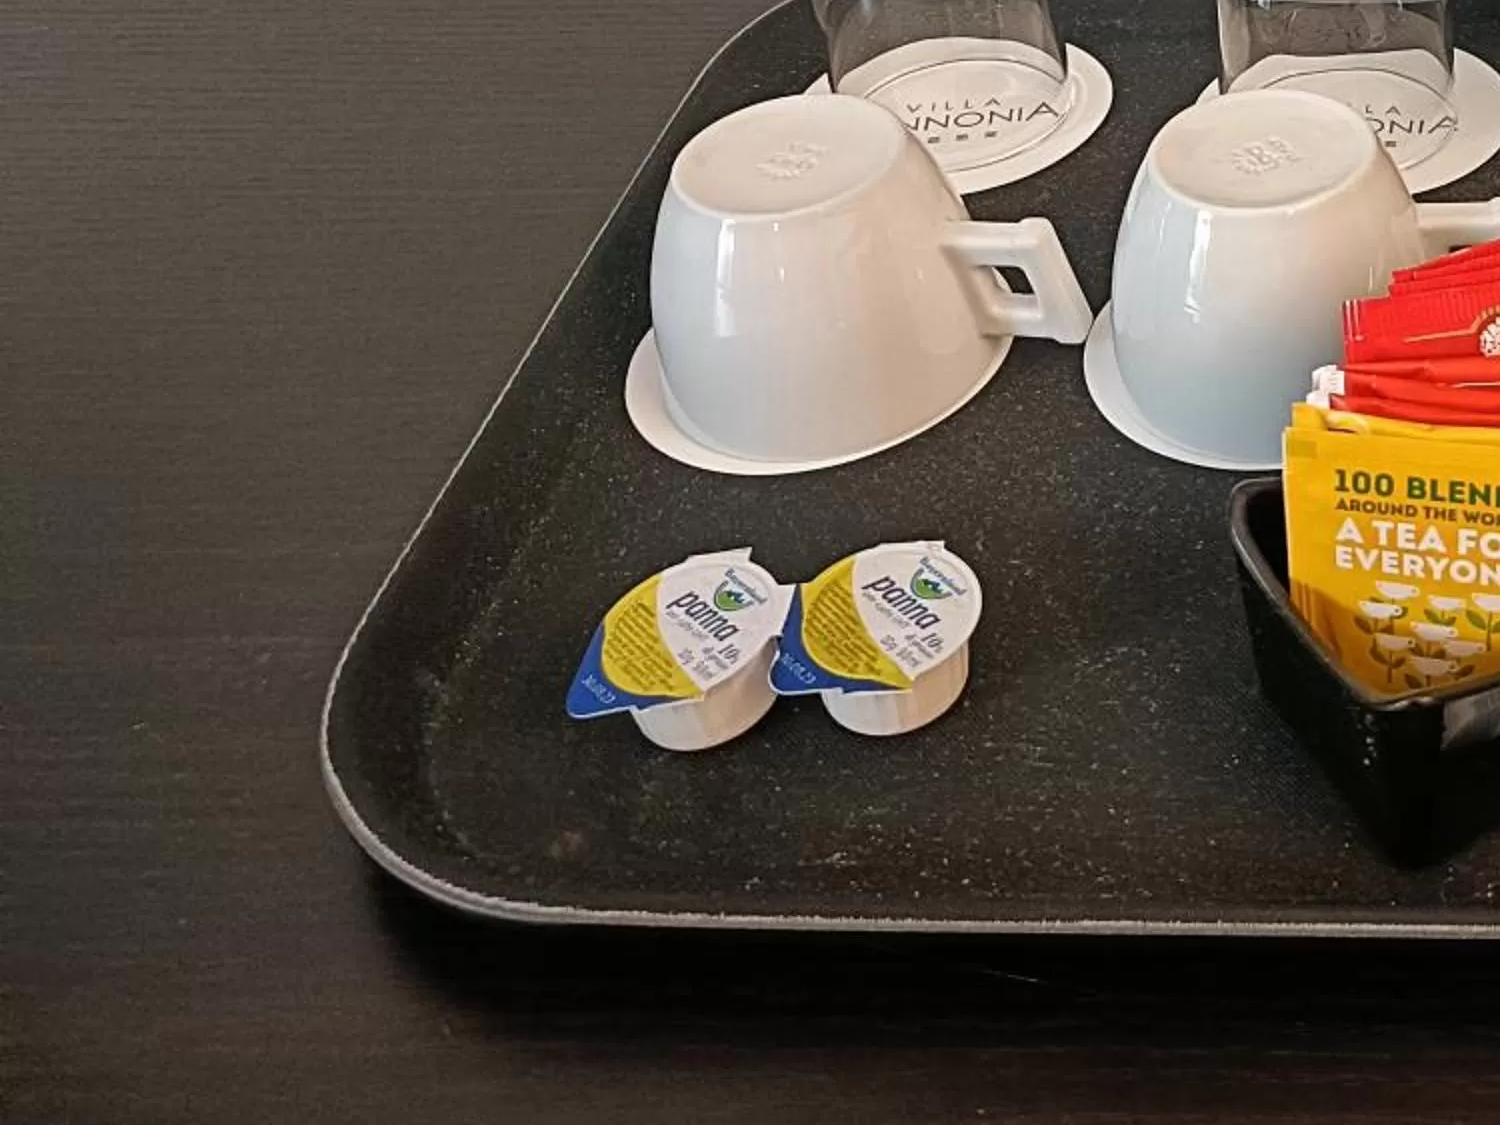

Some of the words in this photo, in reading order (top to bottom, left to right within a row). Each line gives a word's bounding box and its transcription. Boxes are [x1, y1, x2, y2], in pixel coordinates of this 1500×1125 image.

[906, 97, 1001, 113] VILLA
[1335, 468, 1394, 497] 100
[1335, 497, 1417, 517] AROUND
[1424, 506, 1457, 522] THE
[1336, 517, 1364, 544] A
[1372, 520, 1447, 553] TEA
[665, 590, 739, 642] panna
[861, 575, 941, 629] panna
